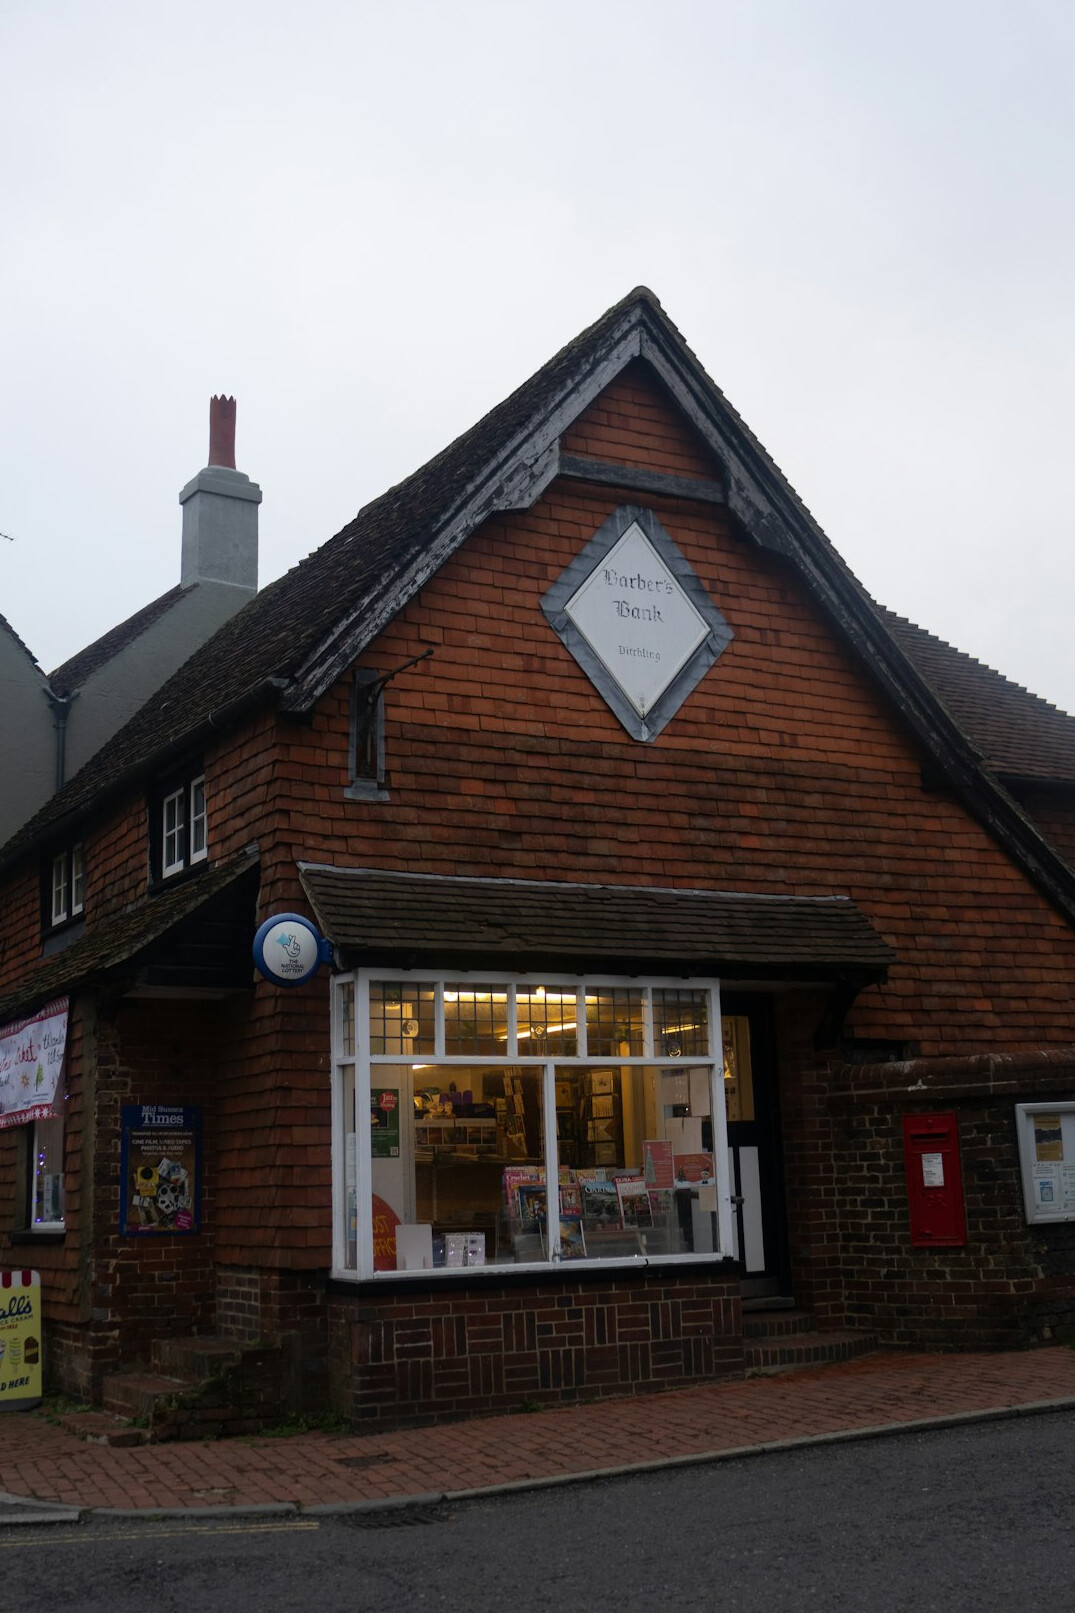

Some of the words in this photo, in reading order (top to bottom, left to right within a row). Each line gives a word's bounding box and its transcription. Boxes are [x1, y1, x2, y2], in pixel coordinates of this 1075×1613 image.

[603, 569, 674, 595] Barber's
[612, 600, 664, 623] Bank
[618, 645, 661, 663] Ditchling
[141, 1112, 184, 1124] Times
[11, 1313, 34, 1323] CREAM
[9, 1376, 30, 1389] HERE
